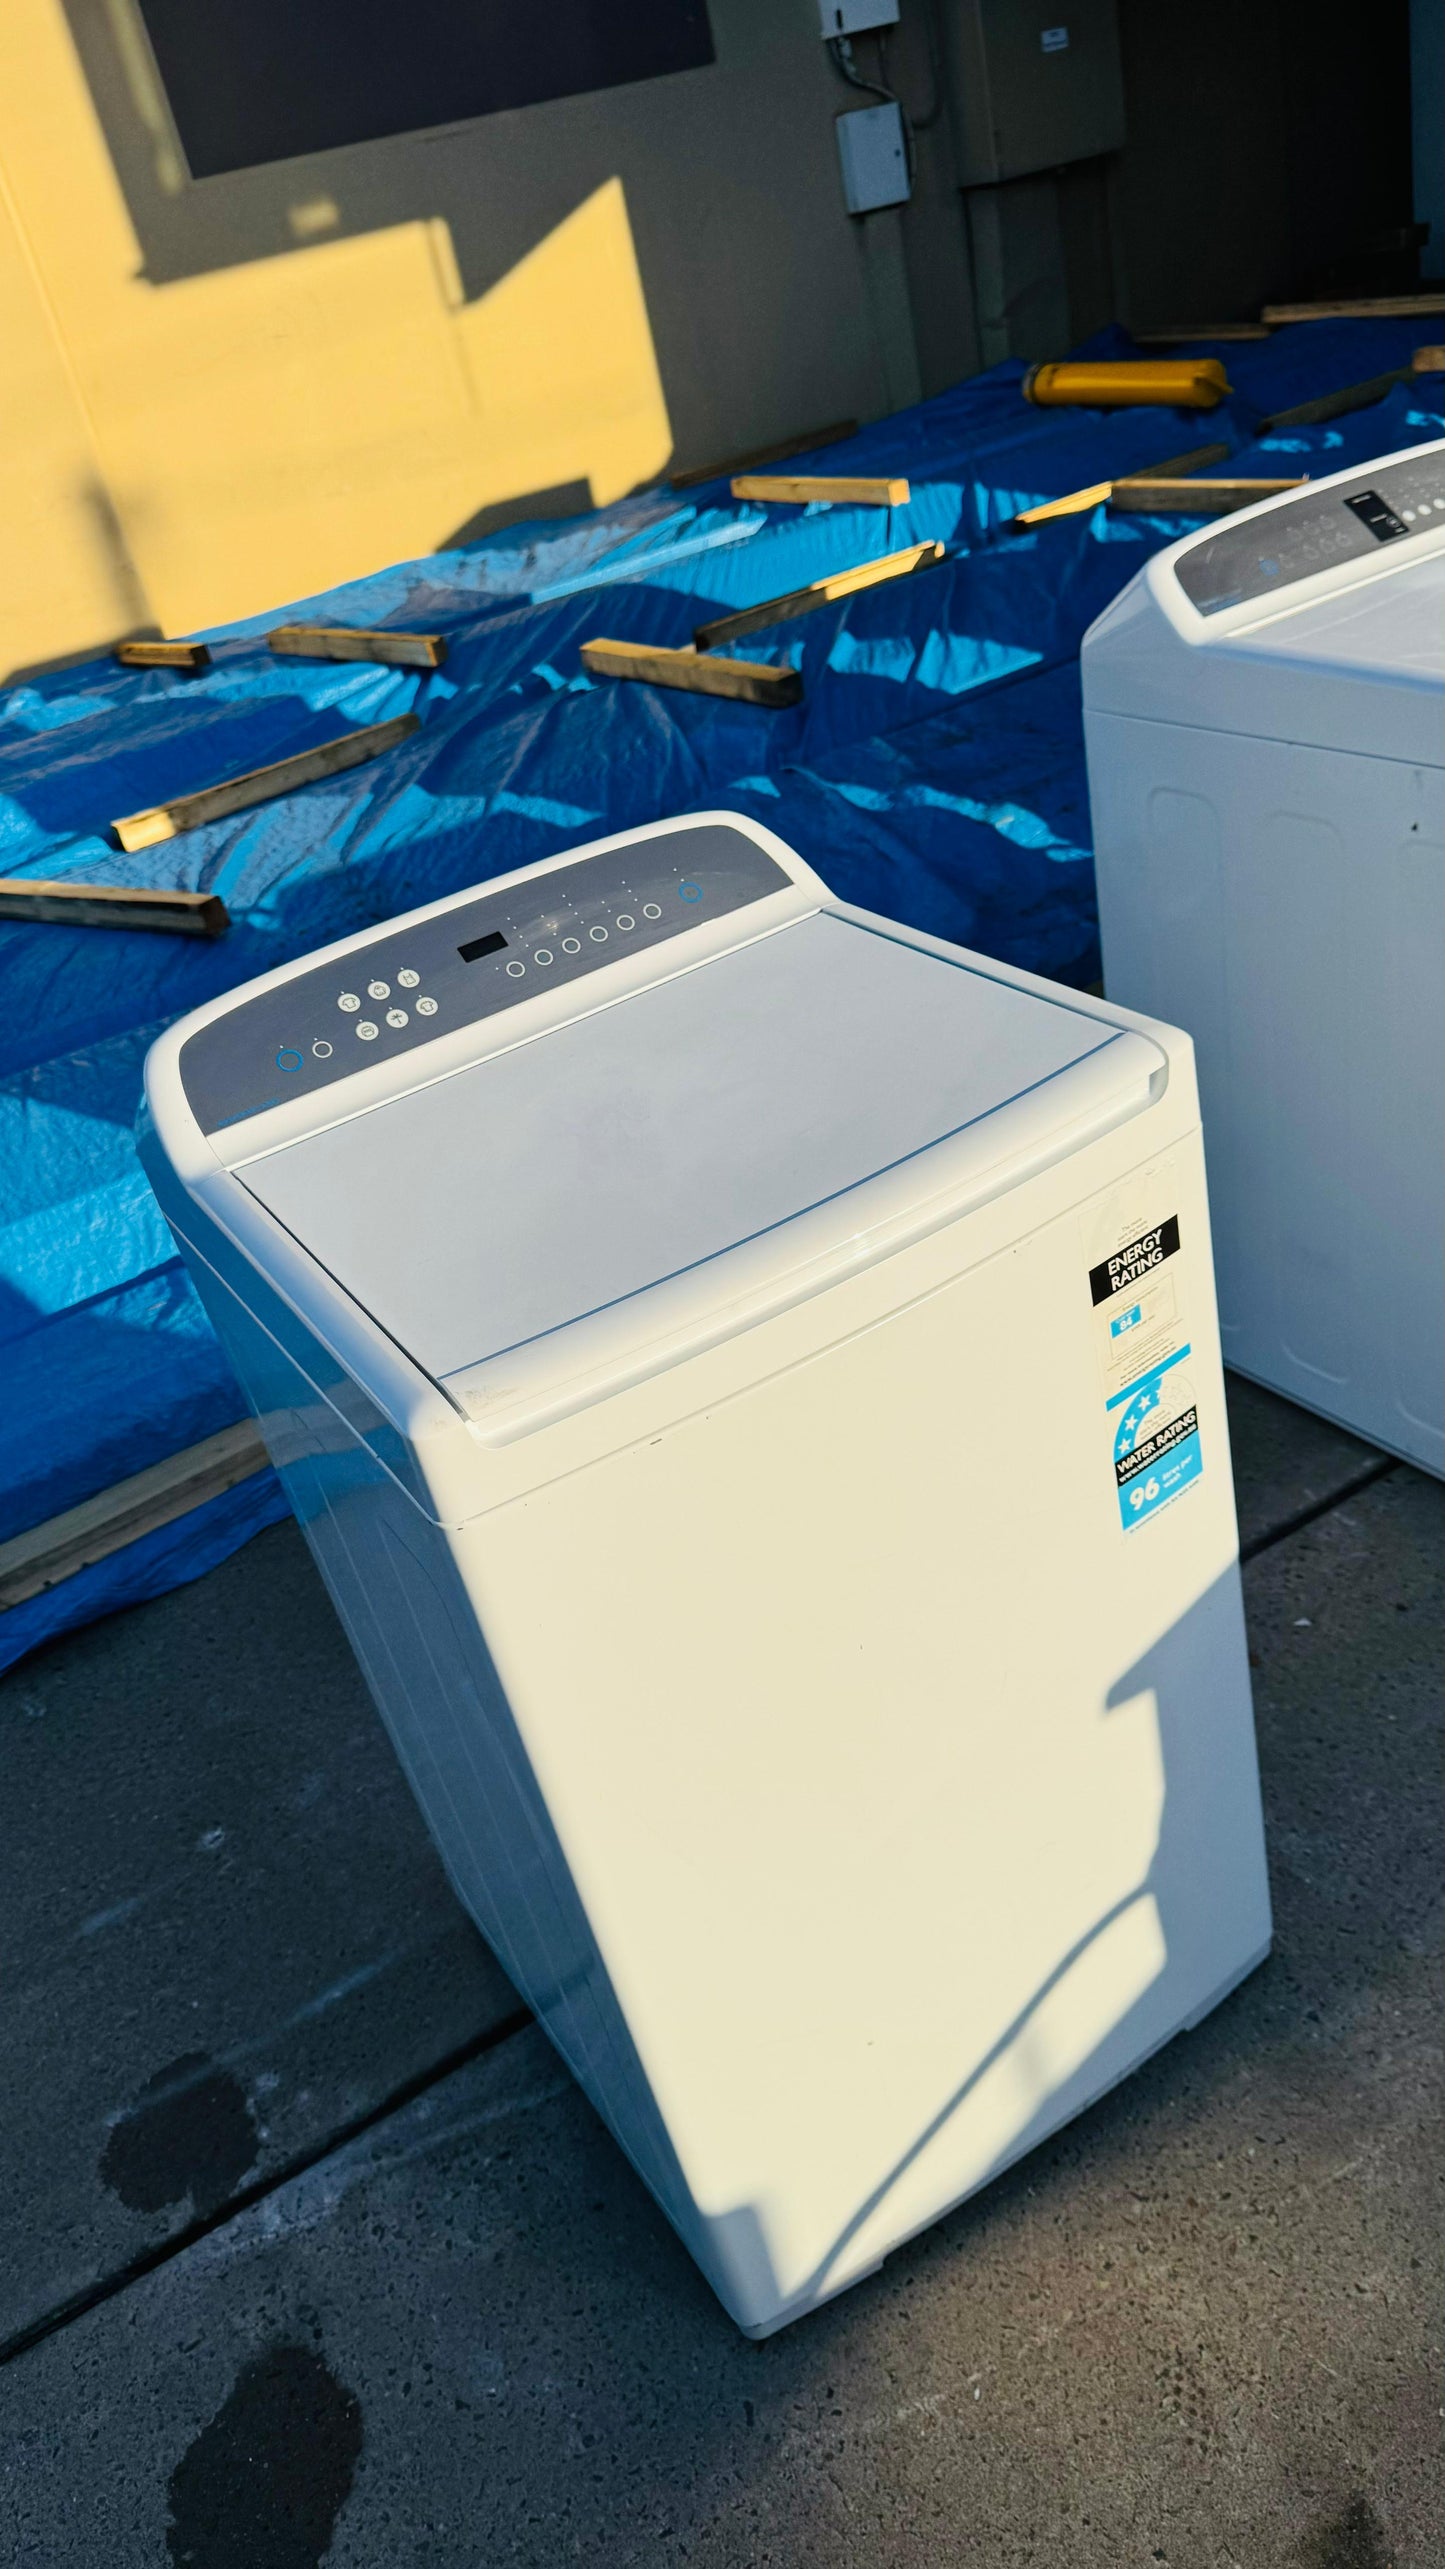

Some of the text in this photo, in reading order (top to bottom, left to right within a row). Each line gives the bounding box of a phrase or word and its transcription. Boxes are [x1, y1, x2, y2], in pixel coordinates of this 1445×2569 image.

[1107, 1228, 1162, 1276] ENERGY
[1111, 1247, 1164, 1291] RATING
[1116, 1441, 1157, 1473] WATER
[1156, 1410, 1196, 1447] RATING
[1129, 1476, 1160, 1511] 96
